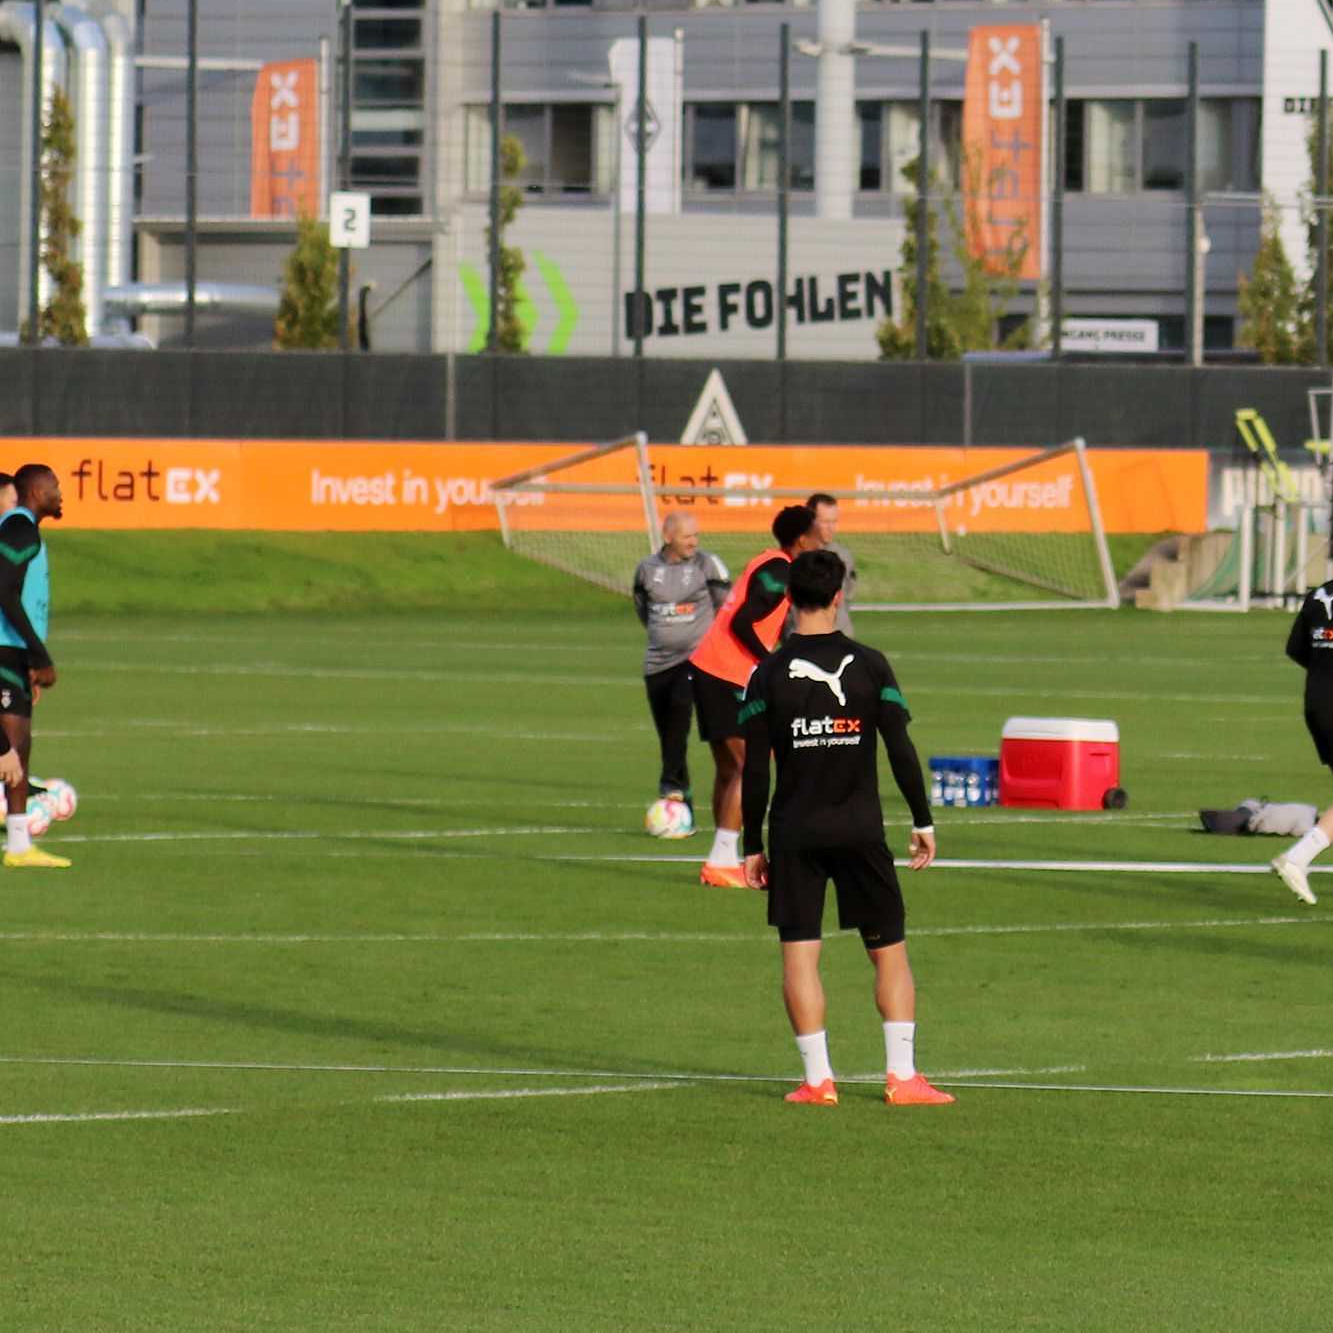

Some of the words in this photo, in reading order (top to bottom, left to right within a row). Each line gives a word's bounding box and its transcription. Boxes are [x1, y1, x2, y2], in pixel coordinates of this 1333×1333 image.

[343, 208, 357, 231] 2
[625, 285, 708, 339] DIE
[718, 270, 894, 330] FOHLEN
[71, 459, 220, 504] flatEX
[310, 467, 396, 505] Invest
[402, 468, 429, 505] in
[970, 476, 1072, 516] yourself
